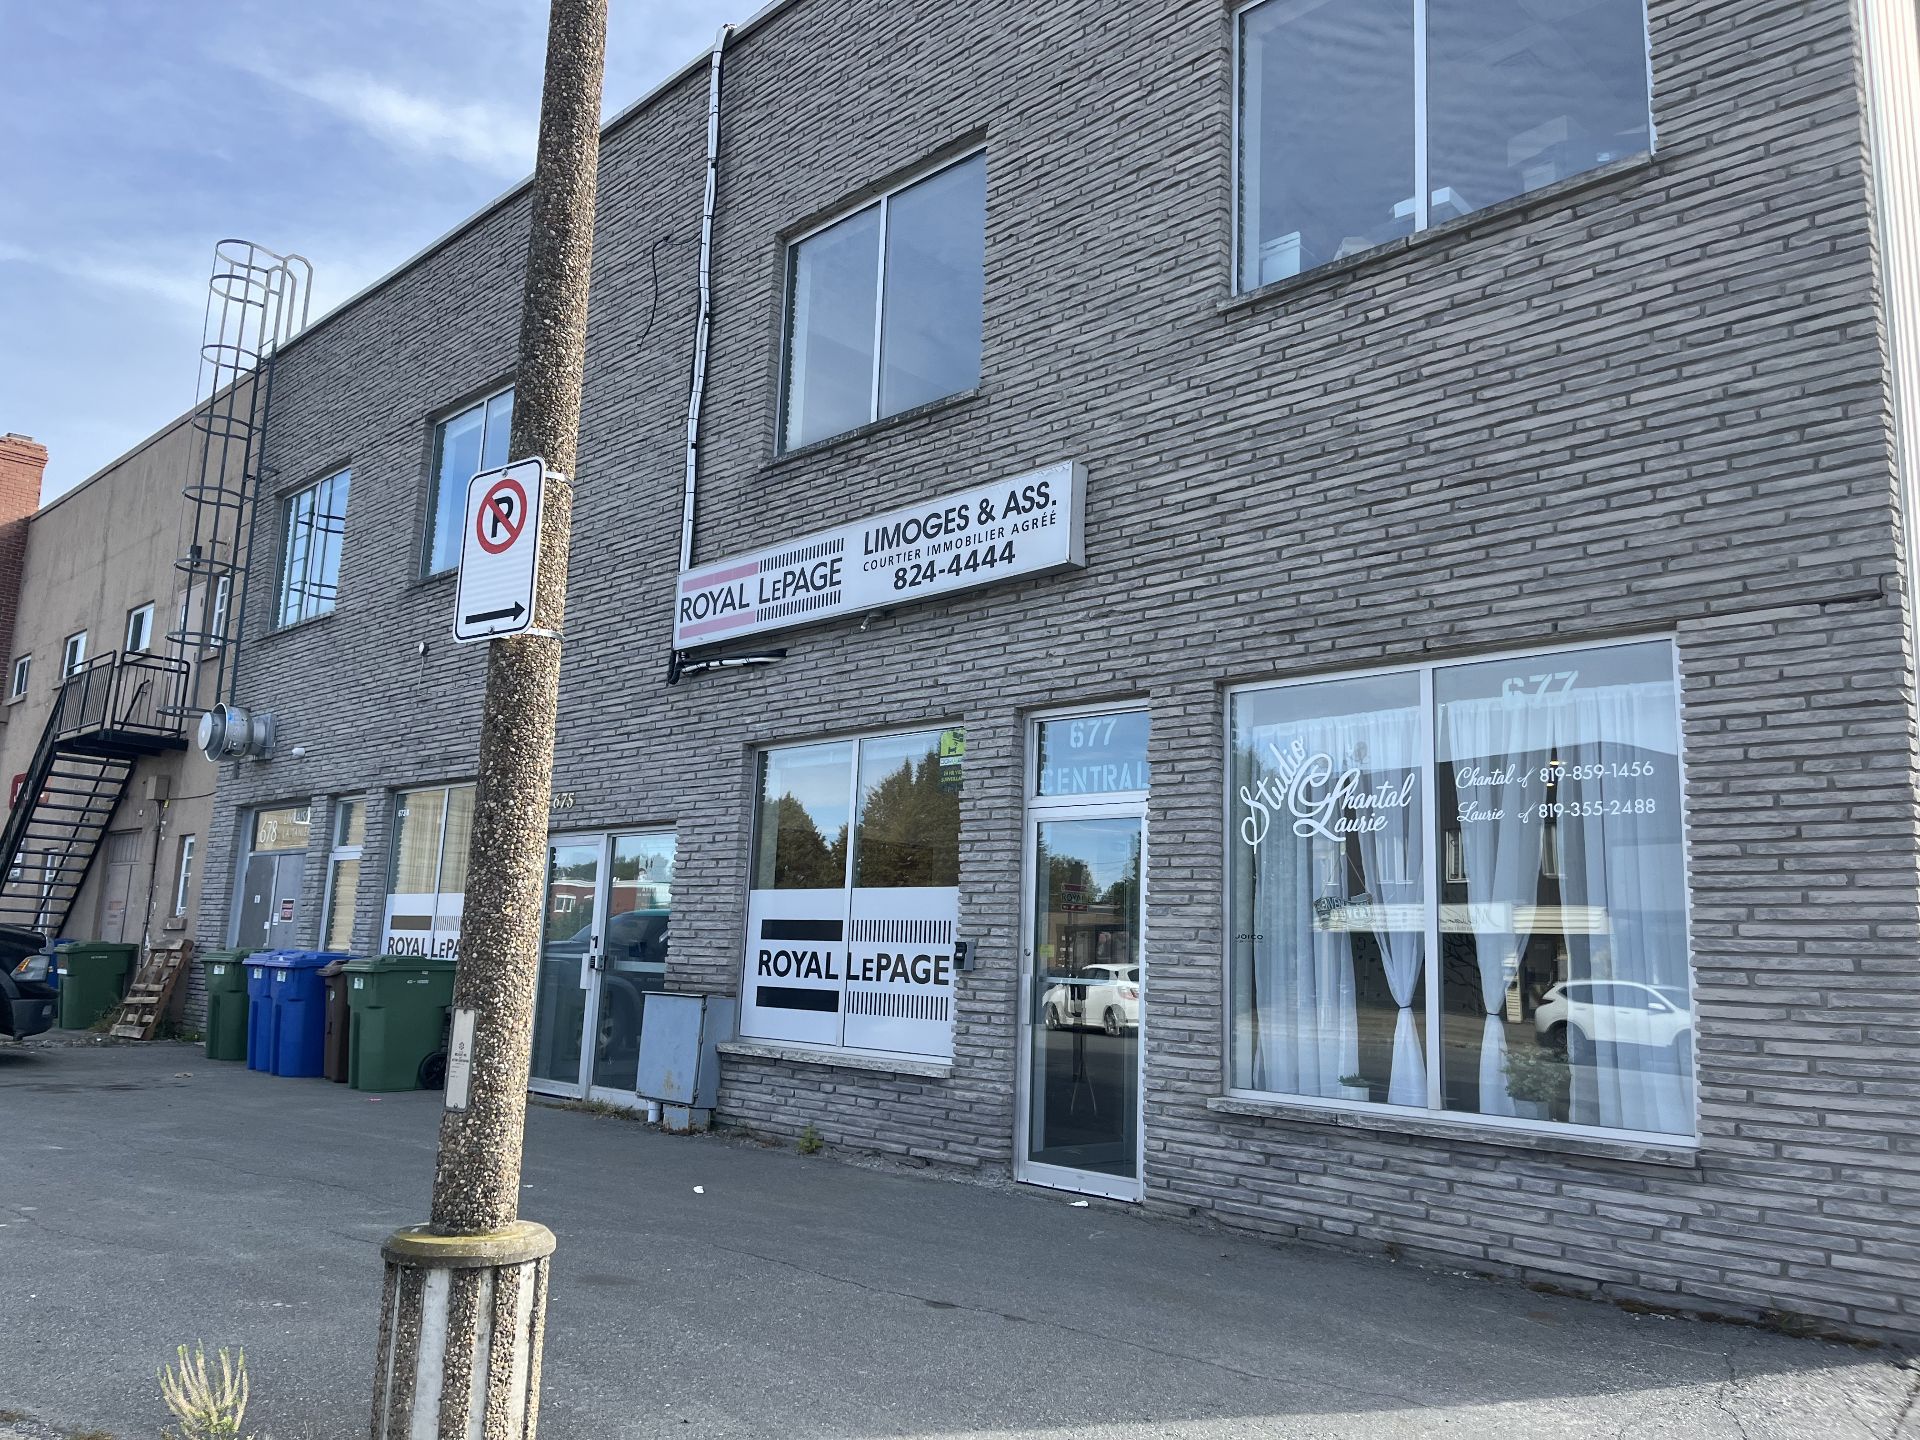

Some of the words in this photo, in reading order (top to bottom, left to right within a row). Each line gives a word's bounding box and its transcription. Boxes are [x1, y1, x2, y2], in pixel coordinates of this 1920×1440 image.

[864, 503, 970, 556] LIMOGES
[977, 498, 997, 526] &
[1002, 481, 1058, 520] ASS.
[863, 548, 921, 572] COURTIER
[926, 527, 1005, 561] IMMOBILIER
[1011, 511, 1057, 538] AGRÉÉ
[893, 540, 1016, 591] 824-4444
[679, 583, 750, 624] ROYAL
[1502, 670, 1579, 709] 677
[1070, 718, 1118, 748] 677
[1040, 760, 1152, 795] CENTRAL
[1287, 752, 1417, 818] Chantal
[1455, 763, 1516, 789] Chantal
[1539, 760, 1655, 783] 819-859-1456
[553, 792, 575, 809] 675
[1240, 736, 1306, 855] Studio
[1456, 800, 1506, 823] Laurie
[1538, 798, 1657, 819] 819-355-2488
[259, 815, 278, 843] 678
[387, 936, 428, 958] ROYAL
[758, 949, 839, 980] ROYAL
